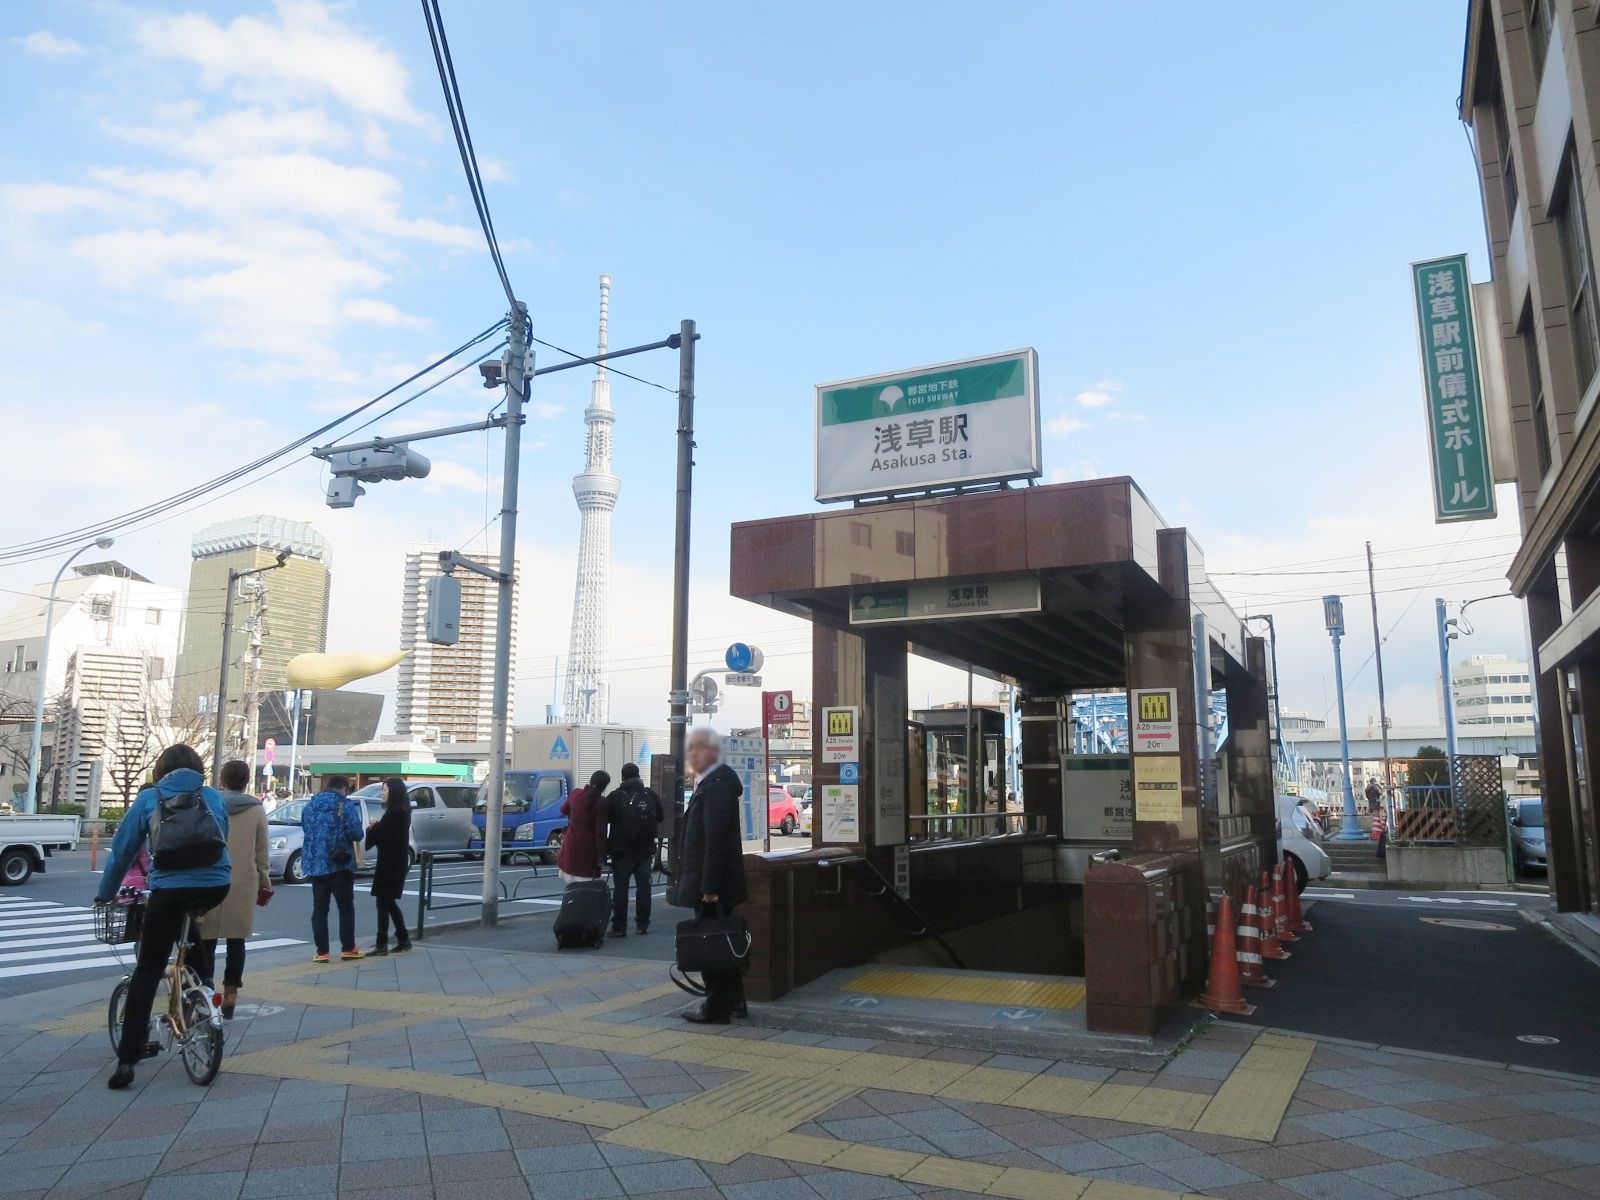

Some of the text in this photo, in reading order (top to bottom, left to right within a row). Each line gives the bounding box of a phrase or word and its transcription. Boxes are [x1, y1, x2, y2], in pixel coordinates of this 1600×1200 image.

[907, 379, 959, 396] 都営地下鉄
[1427, 270, 1480, 505] 浅草駅前儀式ホール
[907, 391, 959, 406] TOEI SUBWAY
[873, 413, 969, 454] 浅草駅
[870, 448, 973, 472] Asakusa Sta.
[947, 585, 989, 601] 浅草駅
[946, 601, 976, 609] Asakusa
[1136, 723, 1151, 731] A2b
[1147, 740, 1163, 749] 20m
[833, 752, 846, 760] 20m
